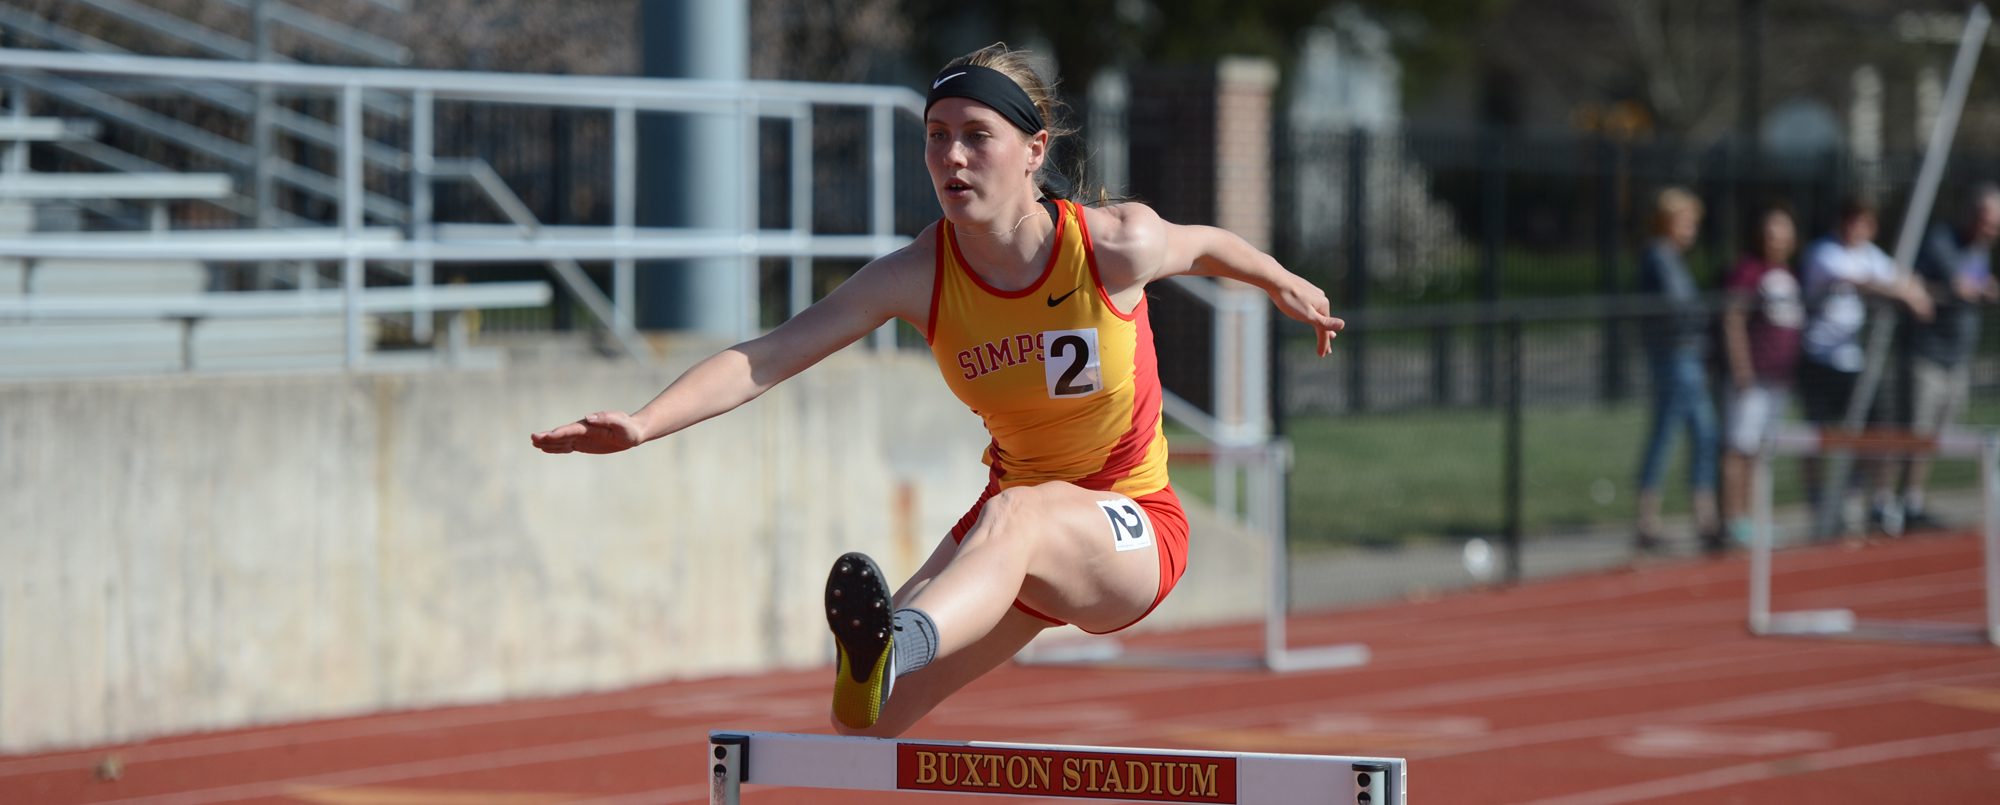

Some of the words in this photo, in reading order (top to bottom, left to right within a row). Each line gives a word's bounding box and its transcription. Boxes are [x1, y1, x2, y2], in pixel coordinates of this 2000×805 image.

[1050, 335, 1094, 396] 2
[1102, 505, 1144, 541] 2
[916, 751, 1053, 790] BUXTON
[1062, 757, 1219, 797] STADIUM
